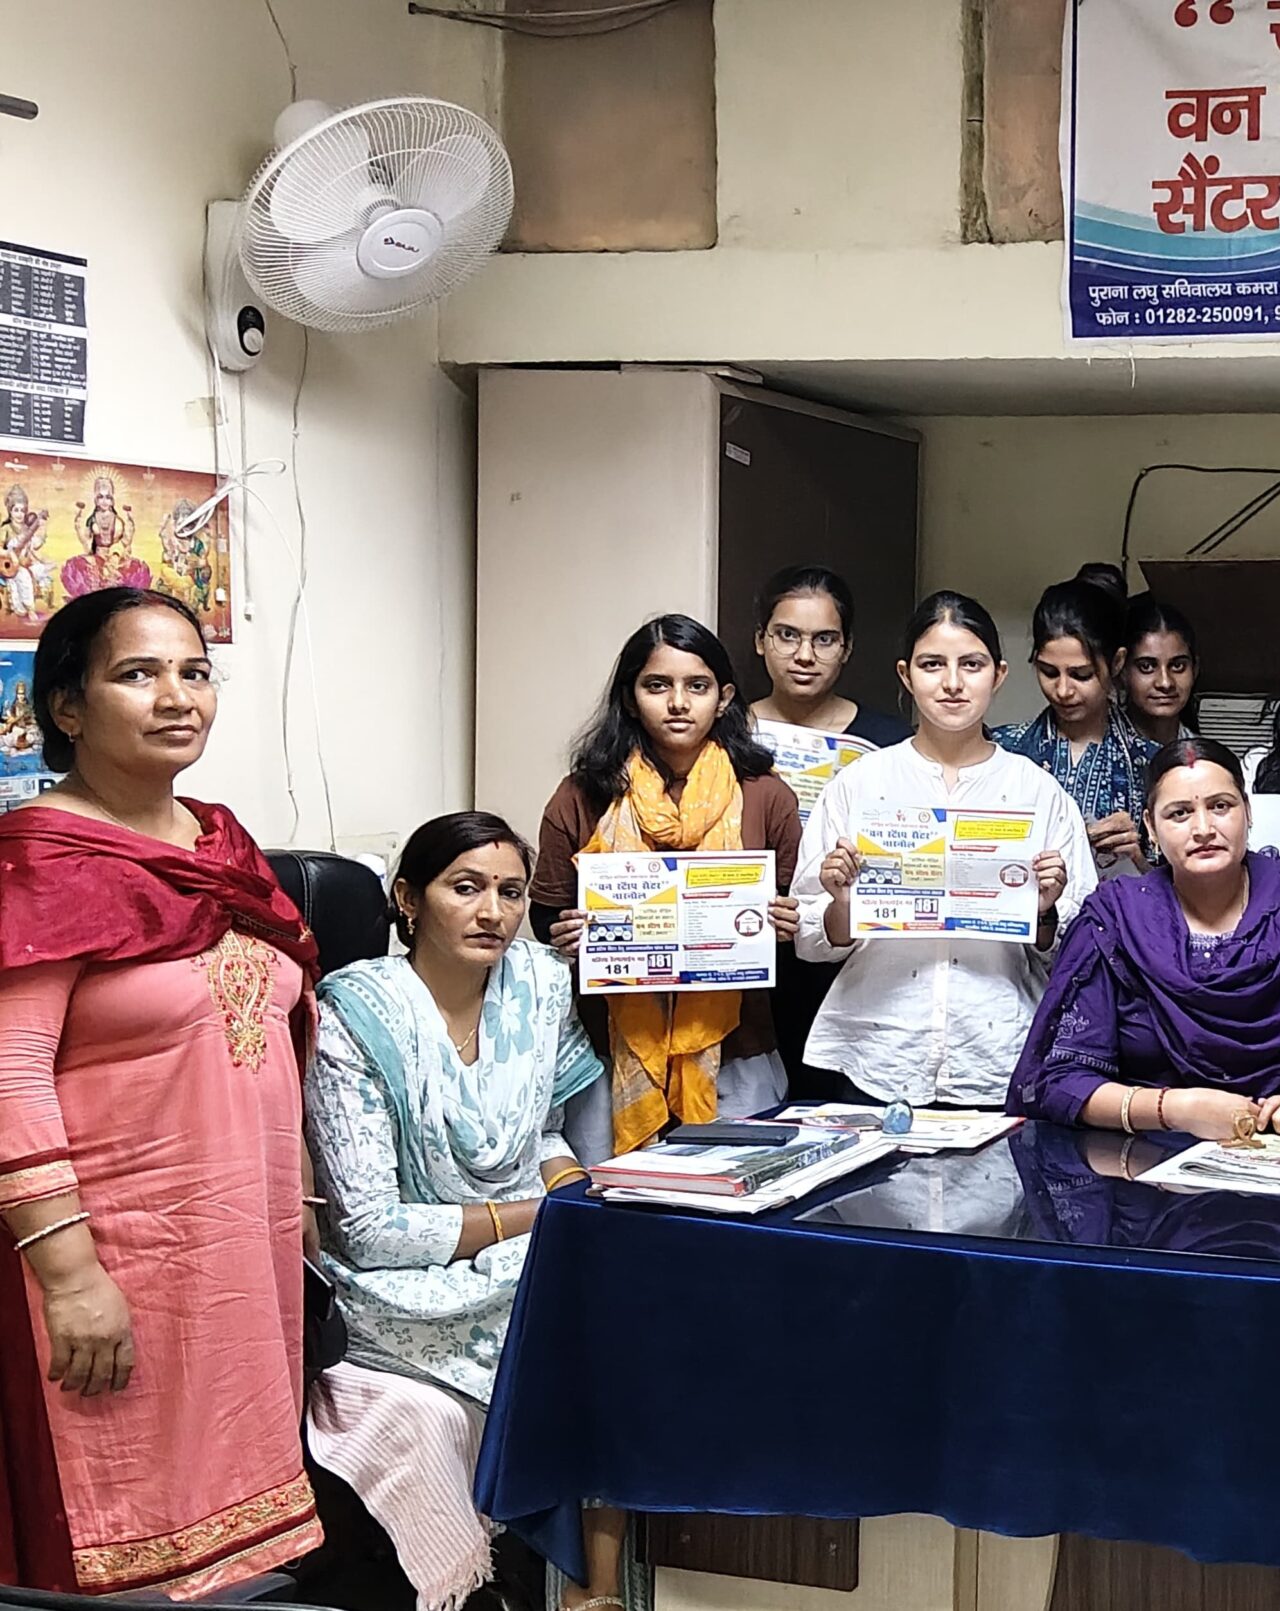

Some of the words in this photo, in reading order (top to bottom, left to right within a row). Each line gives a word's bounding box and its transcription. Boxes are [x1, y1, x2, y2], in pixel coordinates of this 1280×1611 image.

[1165, 86, 1267, 142] वन
[1088, 285, 1129, 307] पुराना
[1132, 285, 1159, 305] लघु
[1161, 278, 1232, 299] सचिवालय
[1236, 281, 1278, 295] कमरा
[1095, 308, 1129, 326] फोन
[1145, 306, 1269, 324] 01282-250091,
[915, 899, 938, 912] 181
[874, 908, 896, 918] 181
[649, 954, 672, 968] 181
[605, 964, 629, 974] 181
